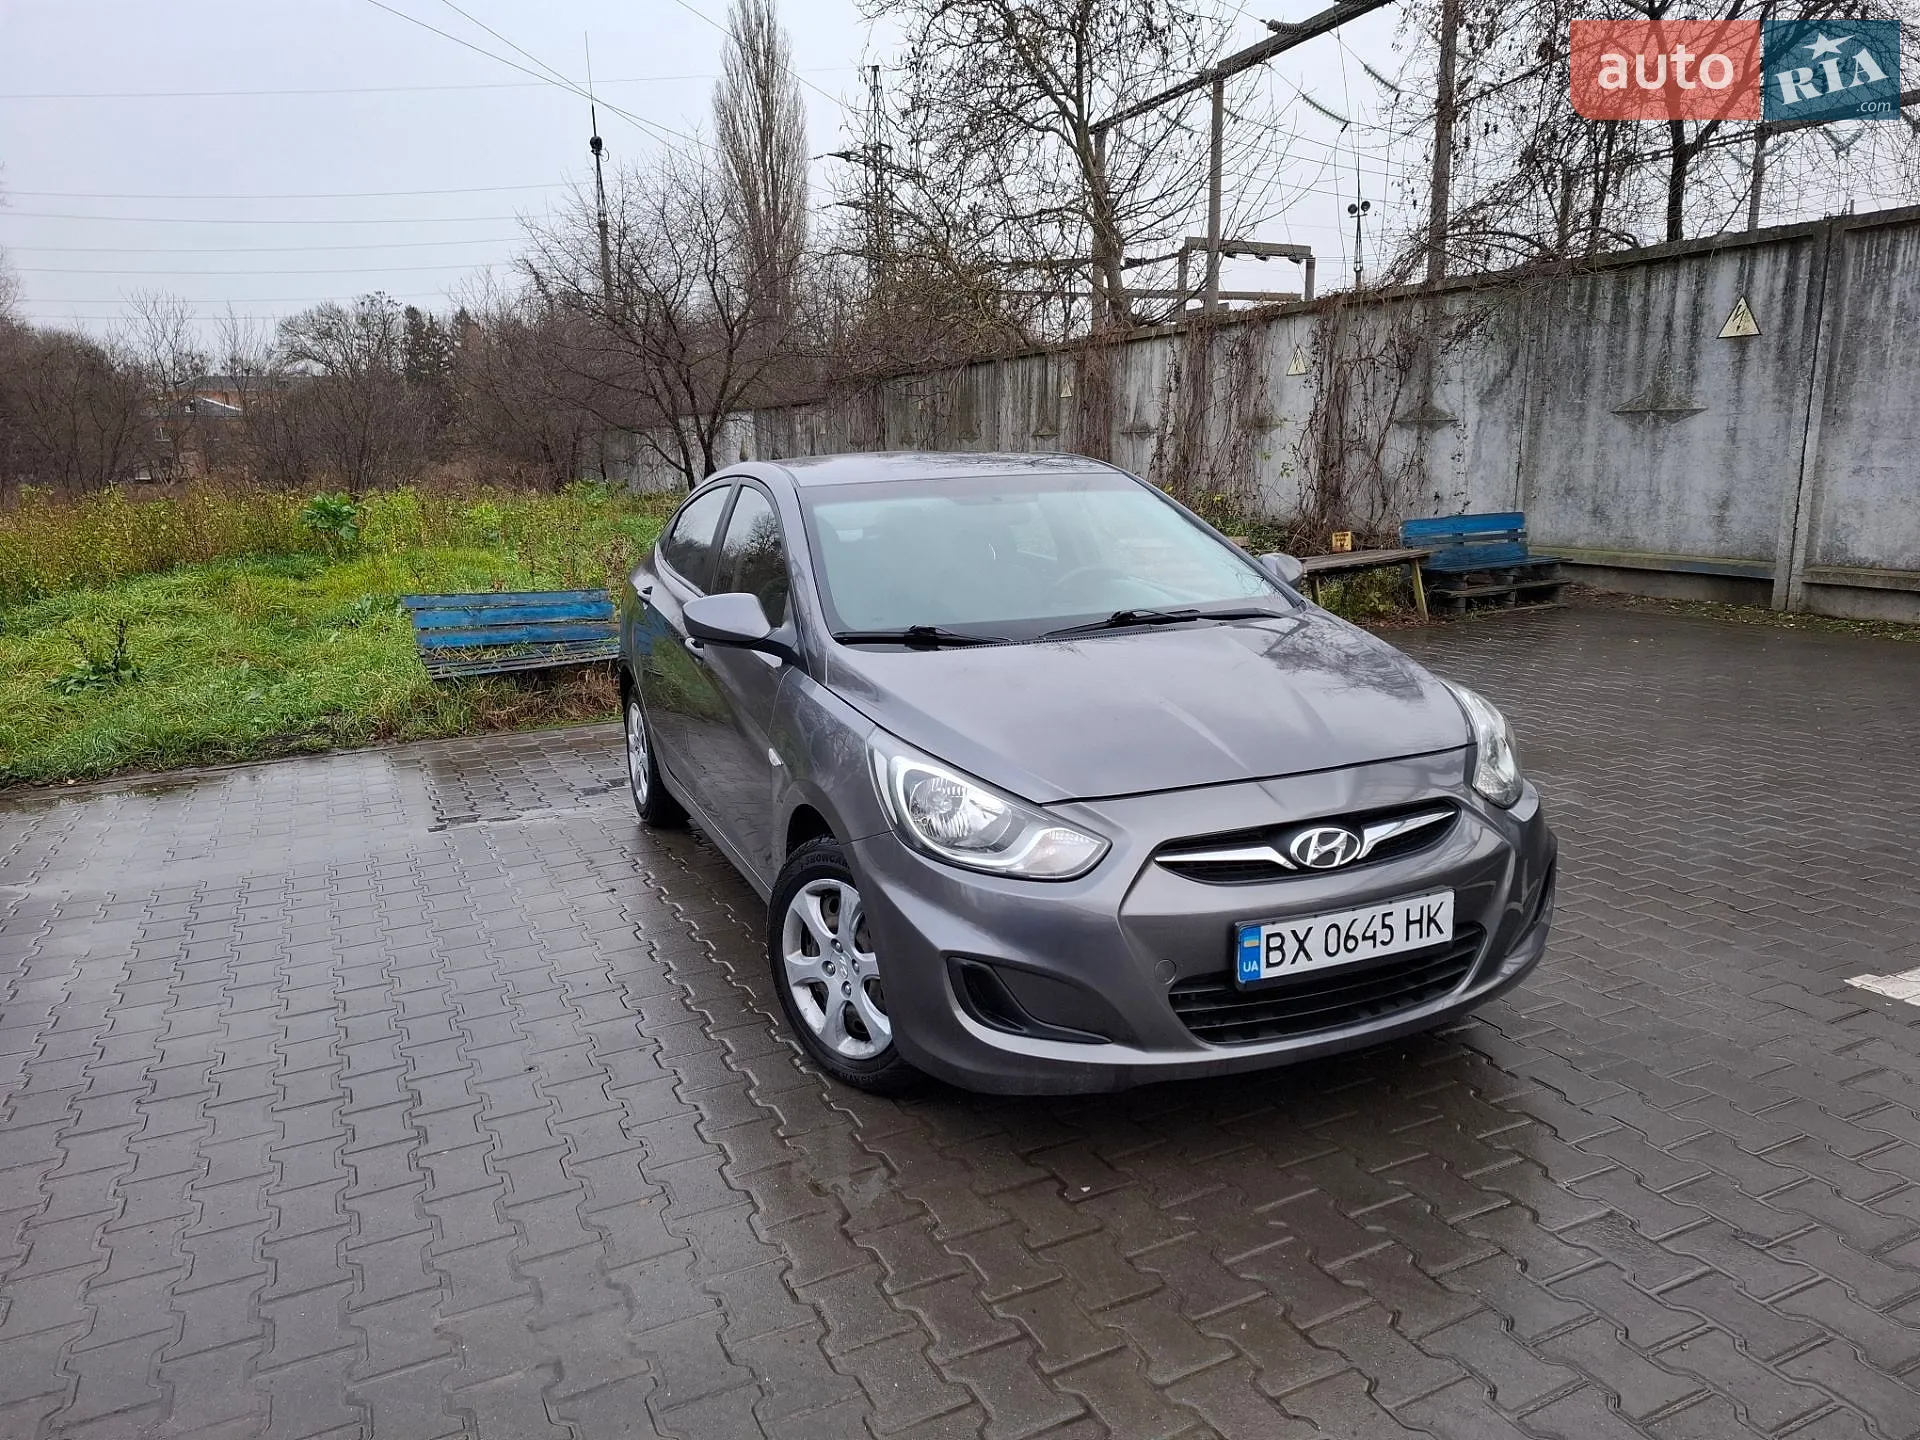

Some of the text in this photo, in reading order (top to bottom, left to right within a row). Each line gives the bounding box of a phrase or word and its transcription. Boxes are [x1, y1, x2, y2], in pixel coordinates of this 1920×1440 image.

[1265, 901, 1445, 969] BX 0645 HK
[1243, 960, 1259, 973] UA
